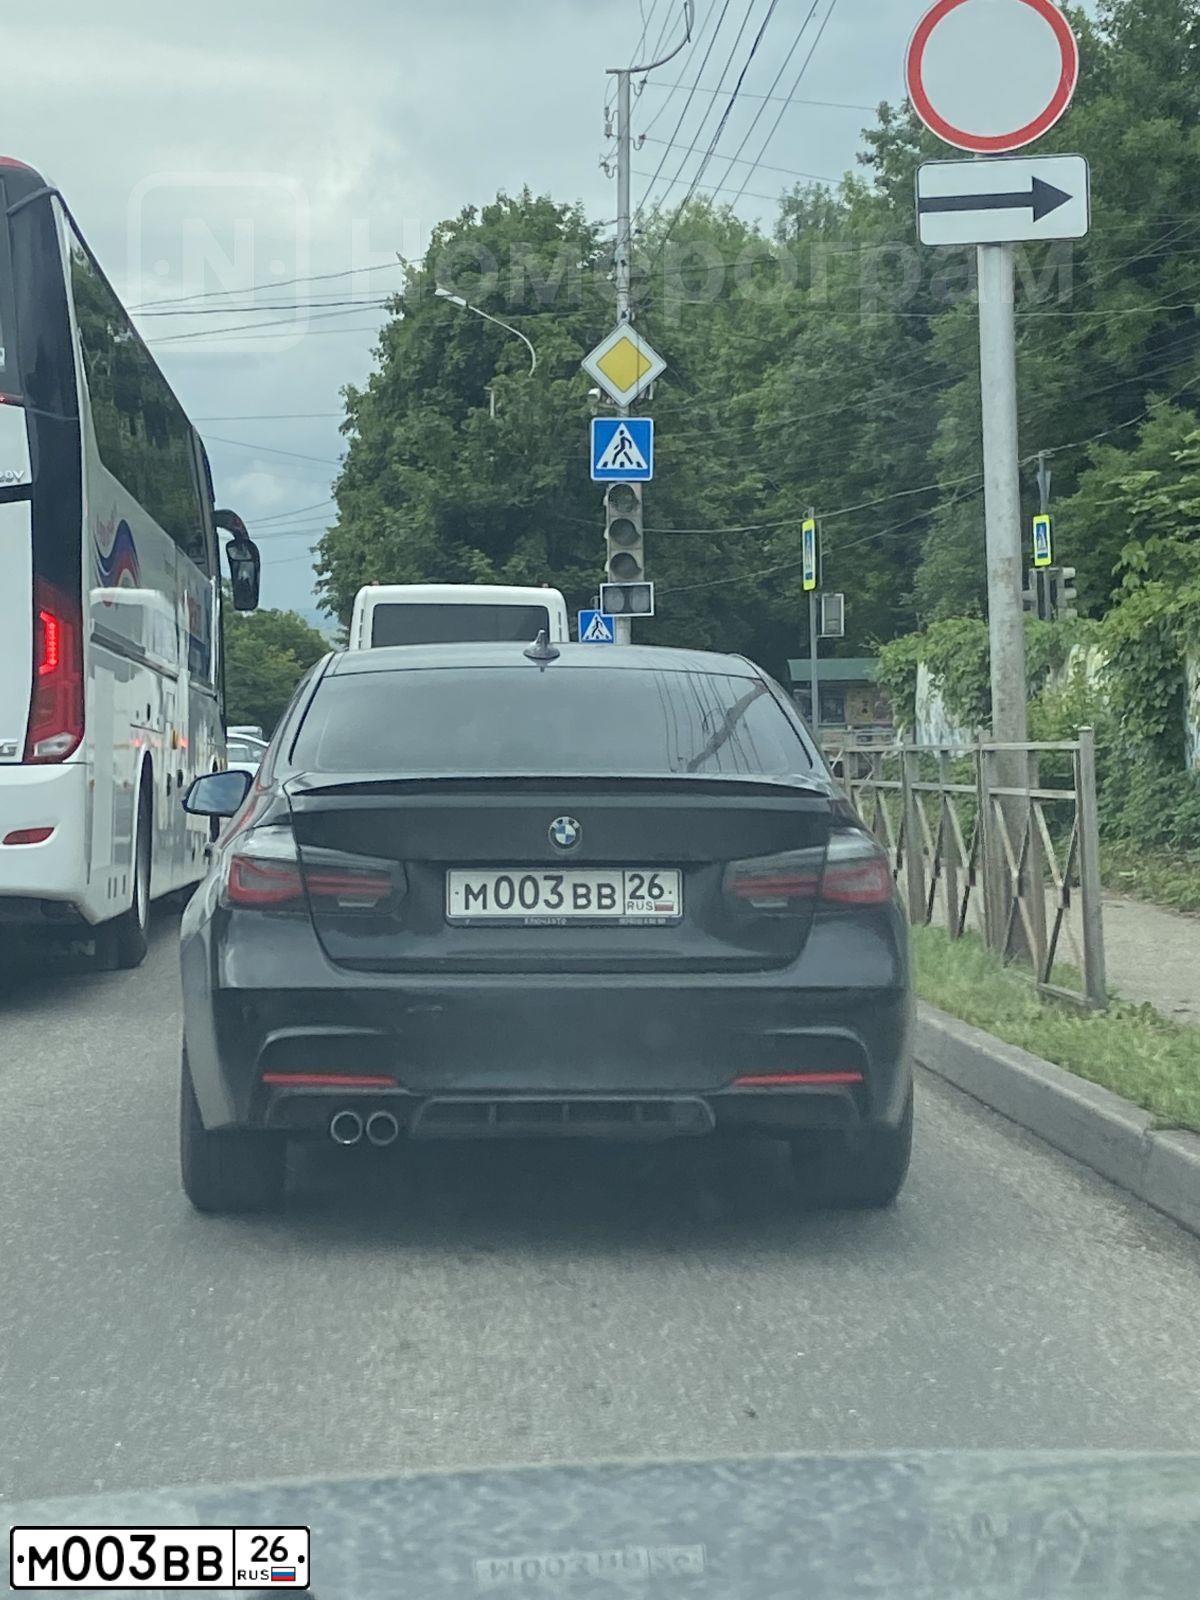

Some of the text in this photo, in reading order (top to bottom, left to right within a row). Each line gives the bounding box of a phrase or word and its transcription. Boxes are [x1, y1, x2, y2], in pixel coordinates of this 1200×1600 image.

[464, 873, 665, 911] М003ВВ 26
[626, 901, 654, 912] RUS
